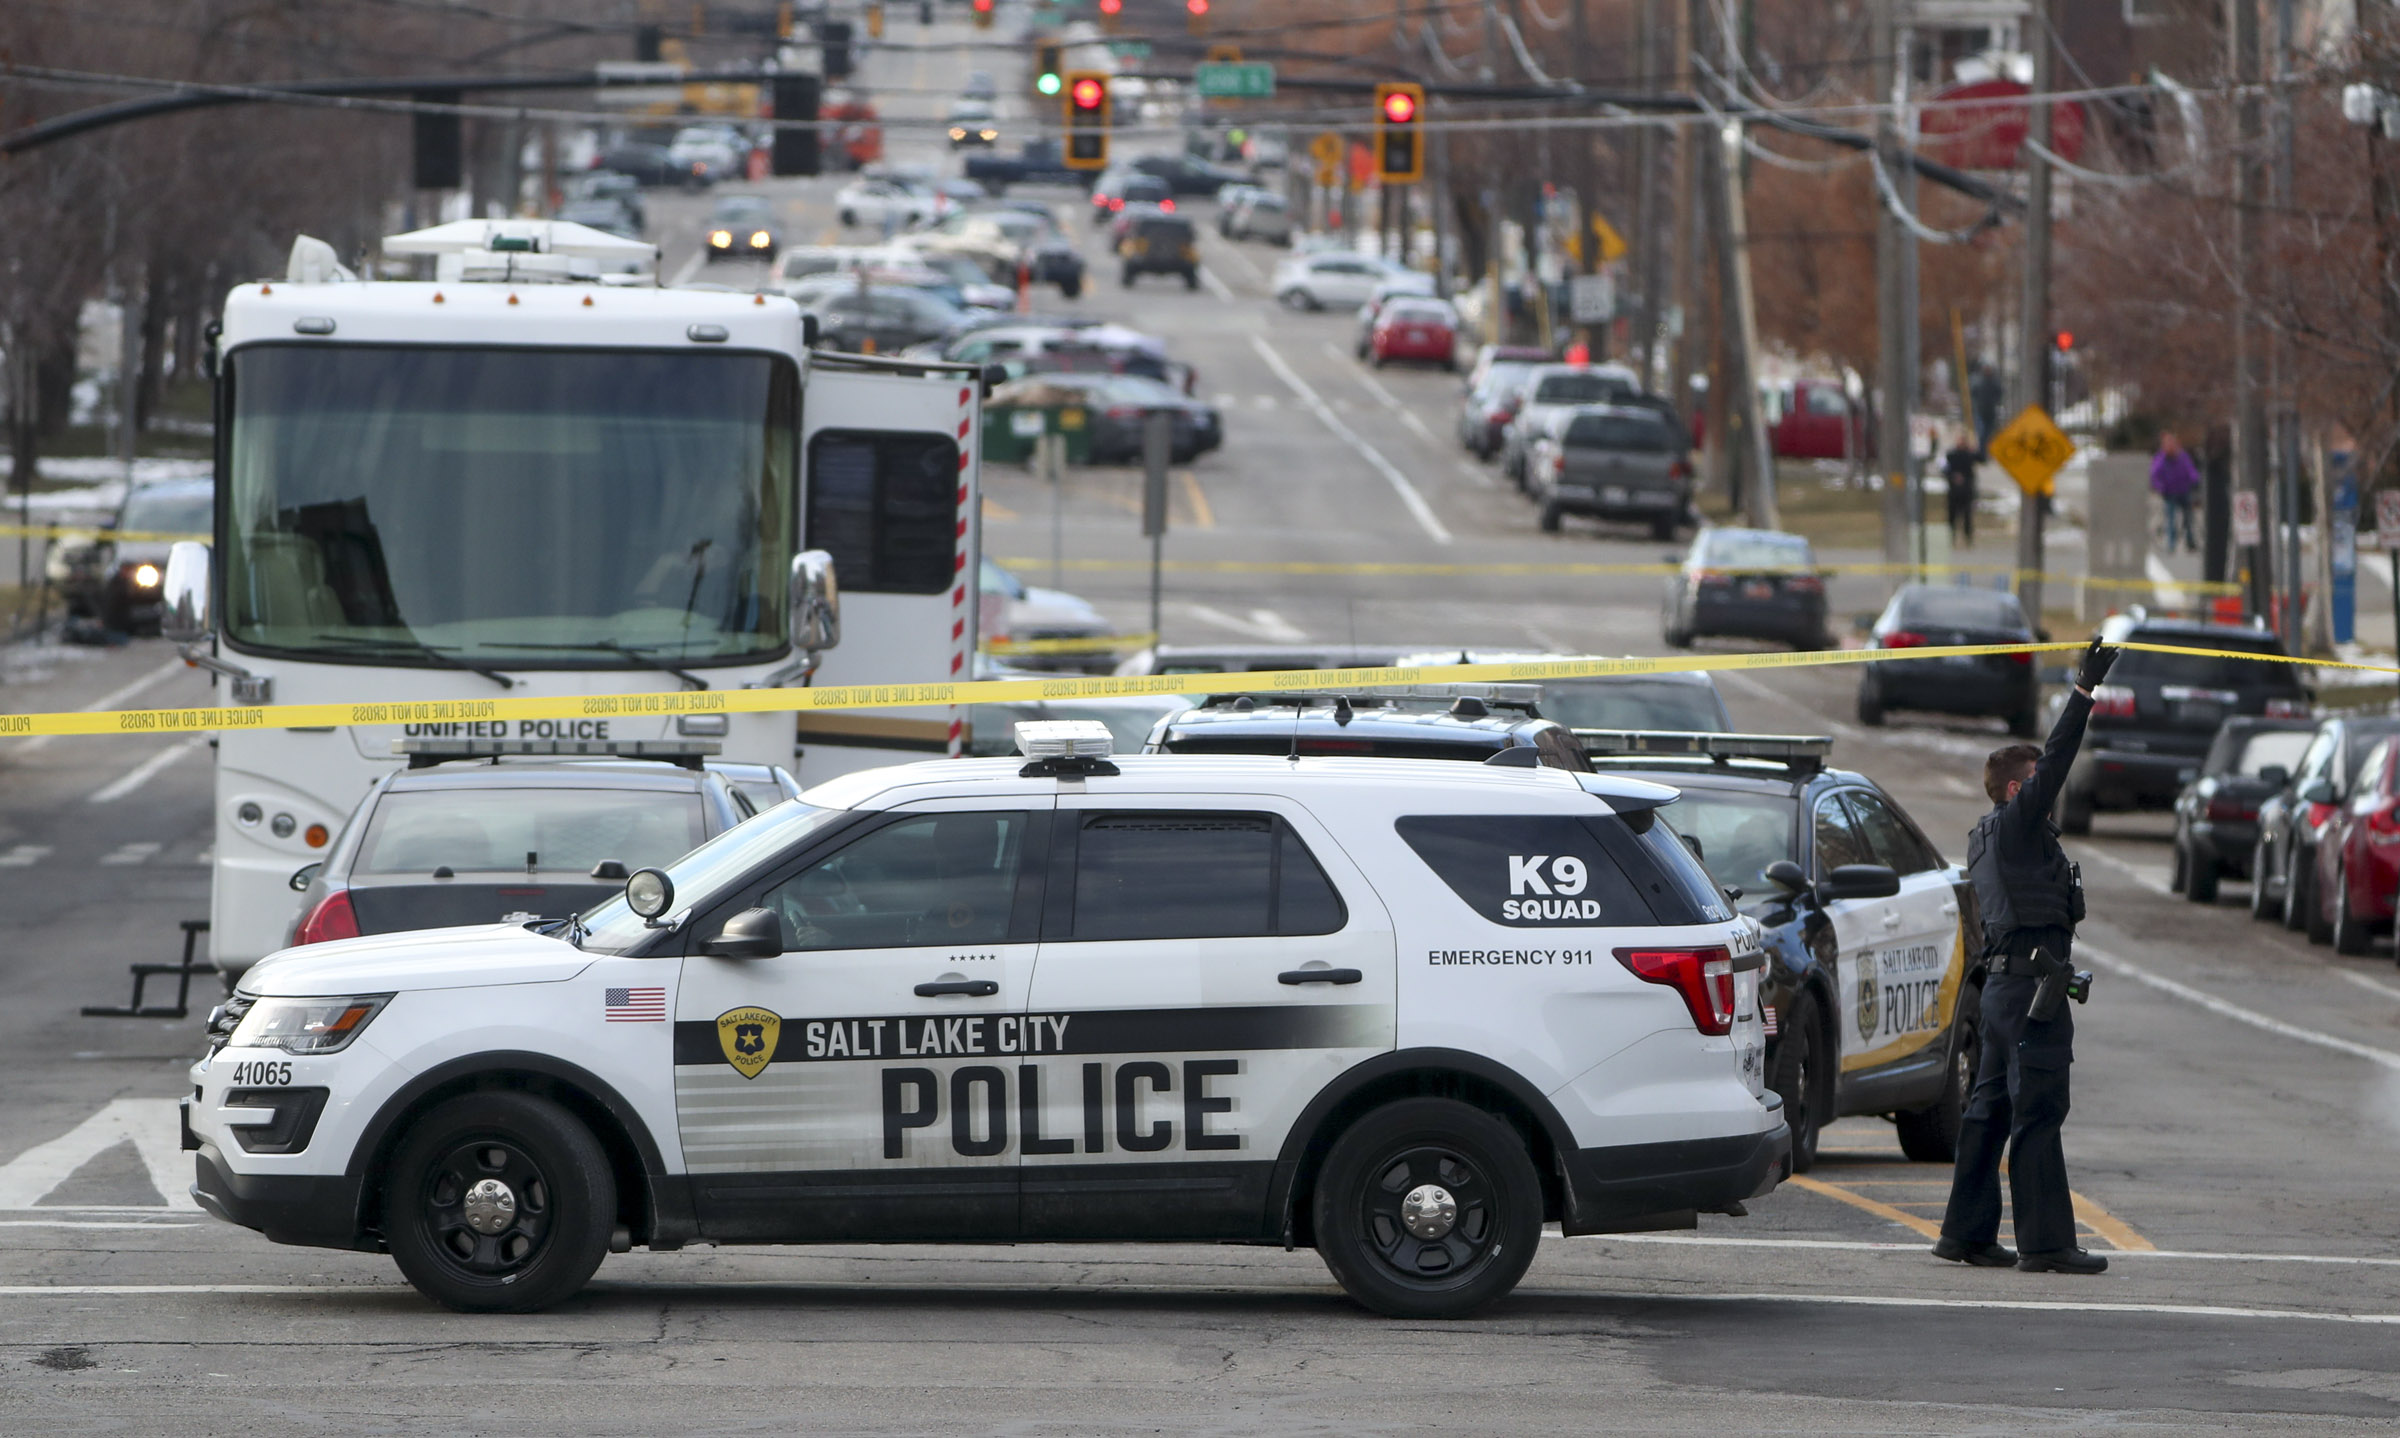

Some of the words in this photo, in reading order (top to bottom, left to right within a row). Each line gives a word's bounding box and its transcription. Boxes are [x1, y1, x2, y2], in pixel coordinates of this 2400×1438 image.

[405, 720, 508, 737] UNIFIED
[520, 720, 609, 739] POLICE
[1508, 855, 1588, 896] K9
[1502, 899, 1601, 920] SQUAD
[1428, 950, 1557, 965] EMERGENCY
[1562, 950, 1592, 965] 911
[1883, 950, 1902, 974] SALT
[1903, 947, 1922, 972] LAKE
[1923, 945, 1939, 970] CITY
[1884, 978, 1939, 1035] POLICE
[720, 1014, 739, 1028] SALT
[740, 1012, 760, 1021] LAKE
[760, 1014, 778, 1027] CITY
[806, 1020, 887, 1058] SALT
[898, 1017, 985, 1055] LAKE
[997, 1015, 1070, 1053] CITY
[734, 1054, 765, 1066] POLICE
[233, 1061, 292, 1085] 41065
[881, 1059, 1244, 1160] POLICE
